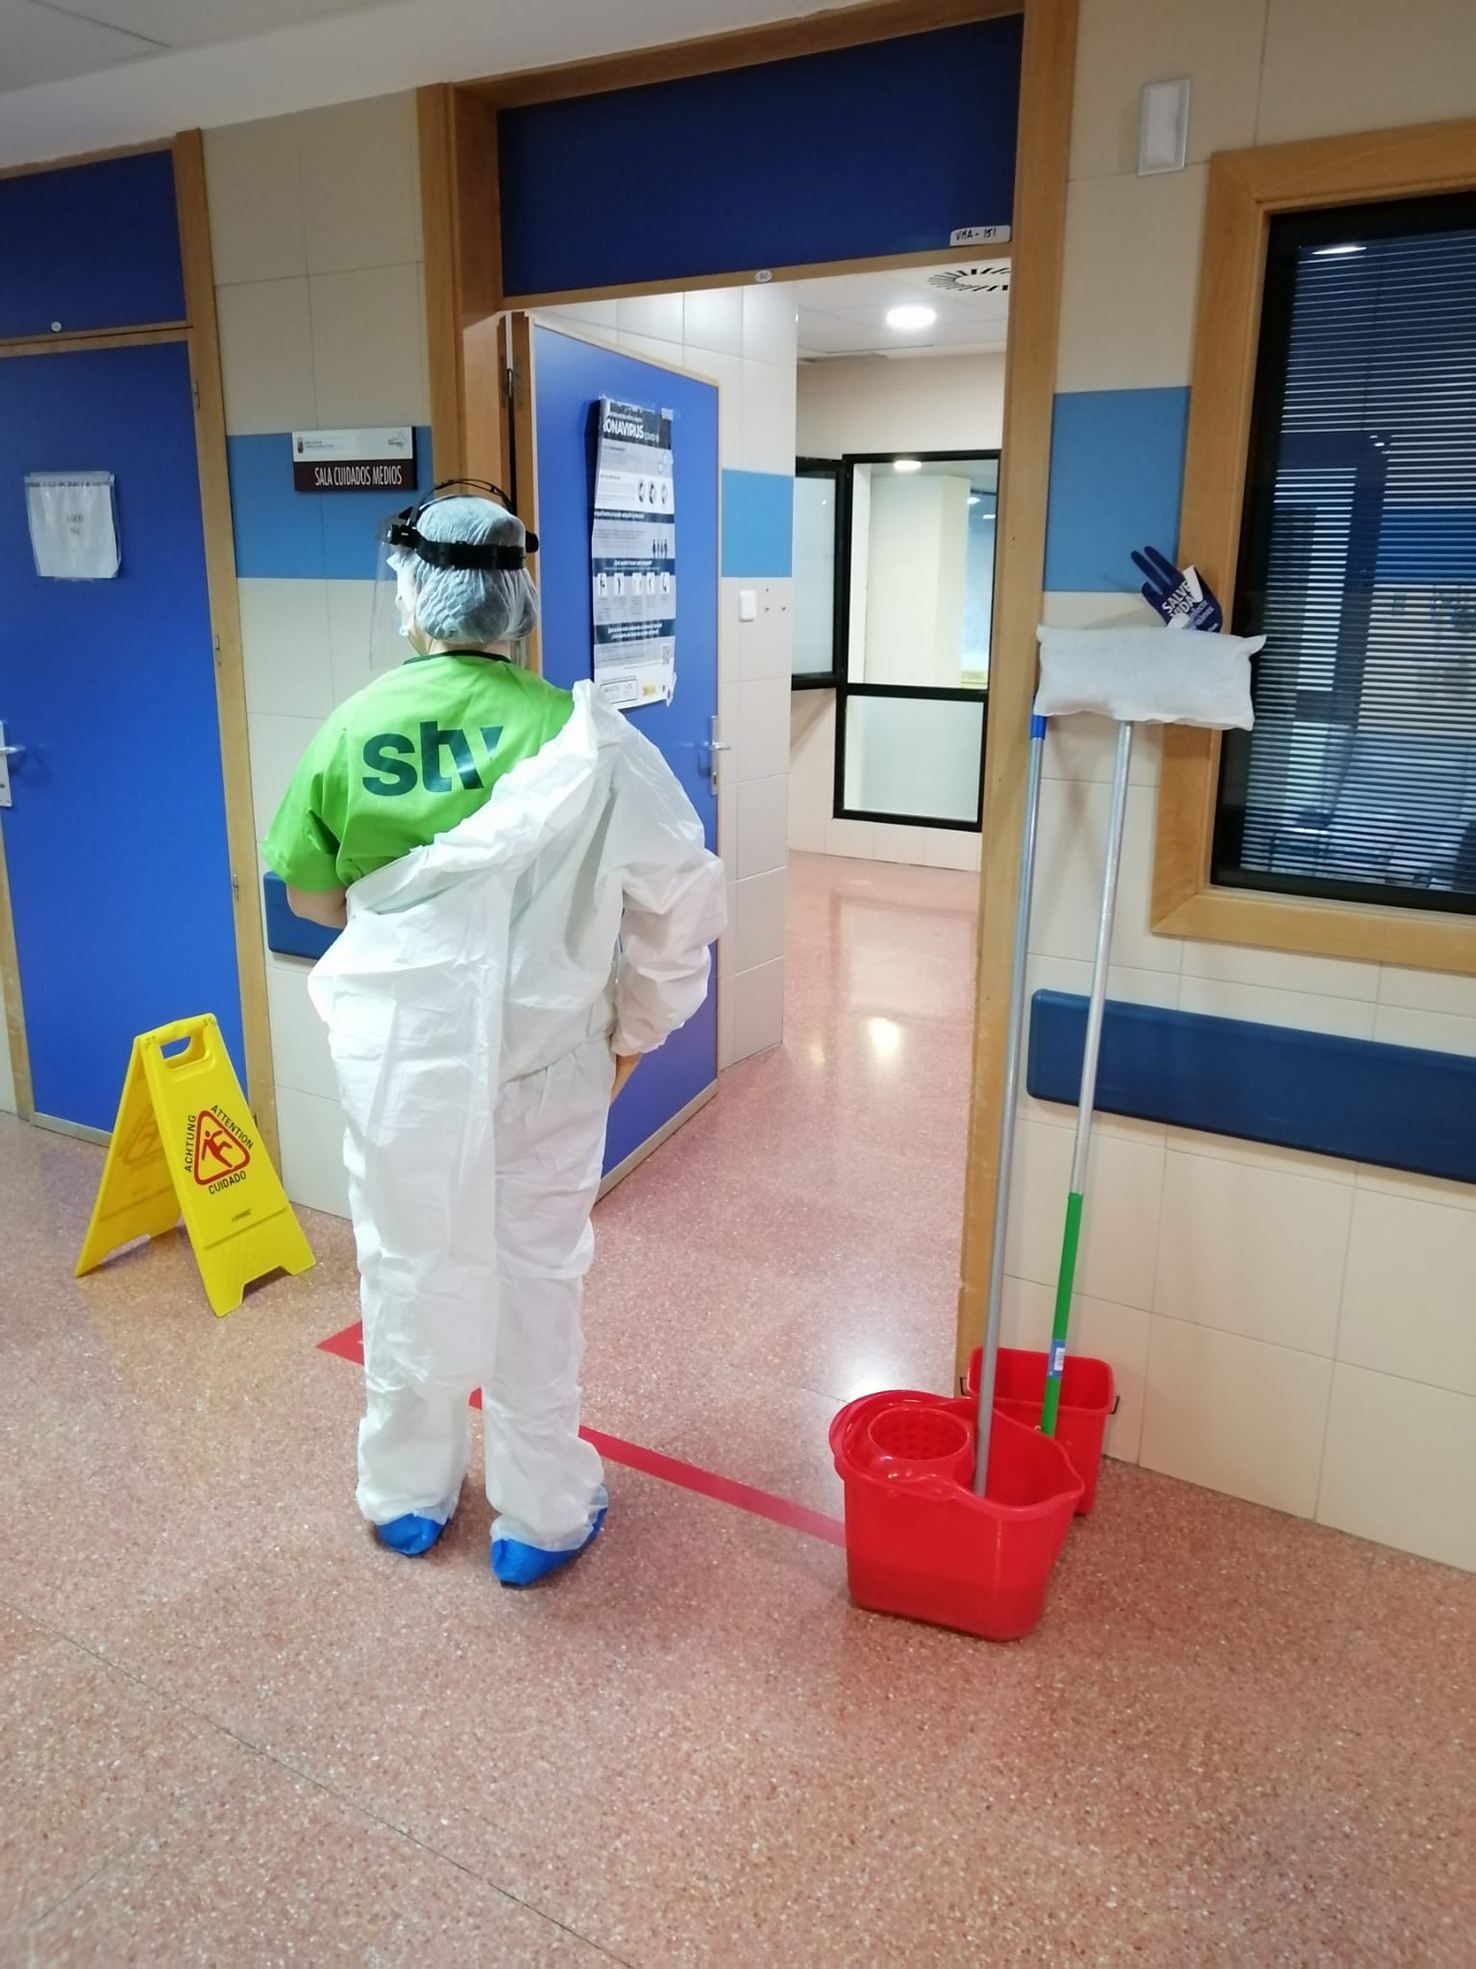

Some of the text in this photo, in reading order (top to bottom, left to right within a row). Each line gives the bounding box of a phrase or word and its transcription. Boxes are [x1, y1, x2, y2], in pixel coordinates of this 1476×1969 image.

[314, 465, 402, 486] SALA CUIDADOS MEDIOS
[184, 1114, 196, 1173] ACHTUNG
[210, 1104, 254, 1149] ATTENTION
[208, 1170, 247, 1195] CUIDADO
